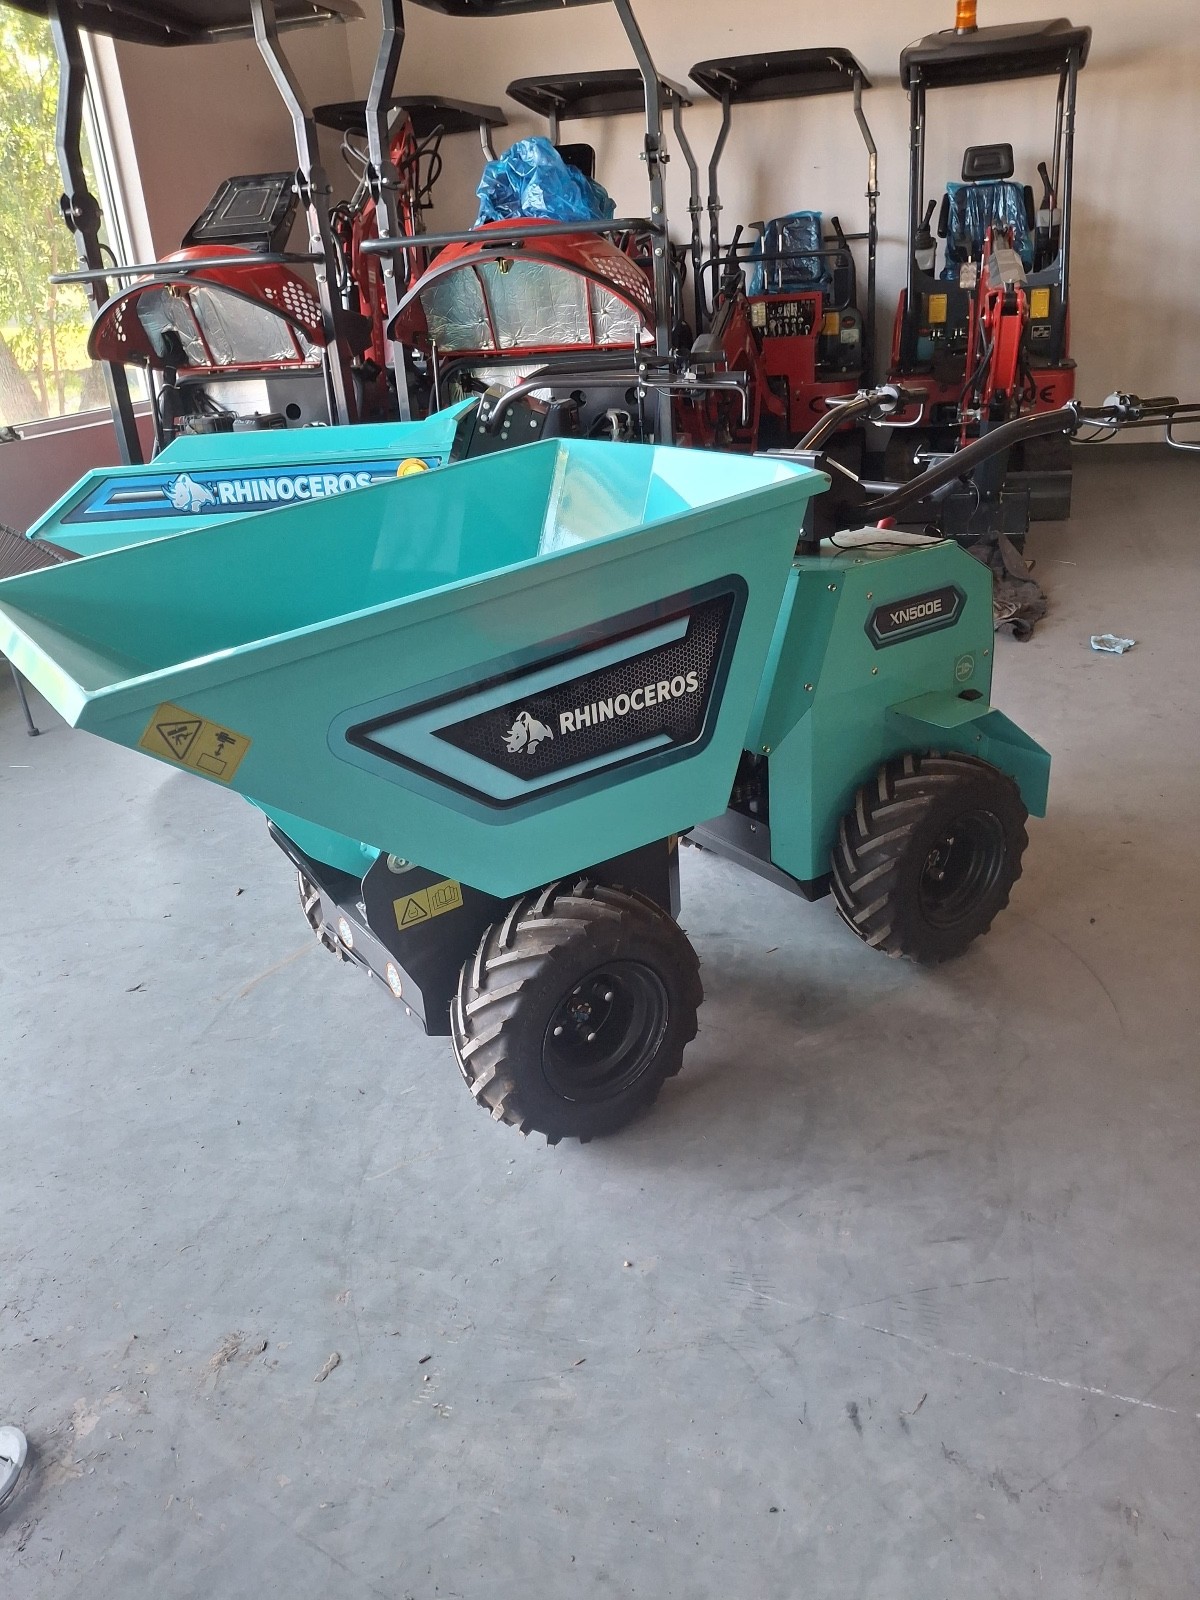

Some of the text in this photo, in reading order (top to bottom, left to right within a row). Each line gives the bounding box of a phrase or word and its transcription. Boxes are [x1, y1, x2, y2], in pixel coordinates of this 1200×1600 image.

[218, 472, 371, 504] RHINOCEROS
[889, 598, 942, 627] XN500E
[559, 670, 699, 735] RHINOCEROS
